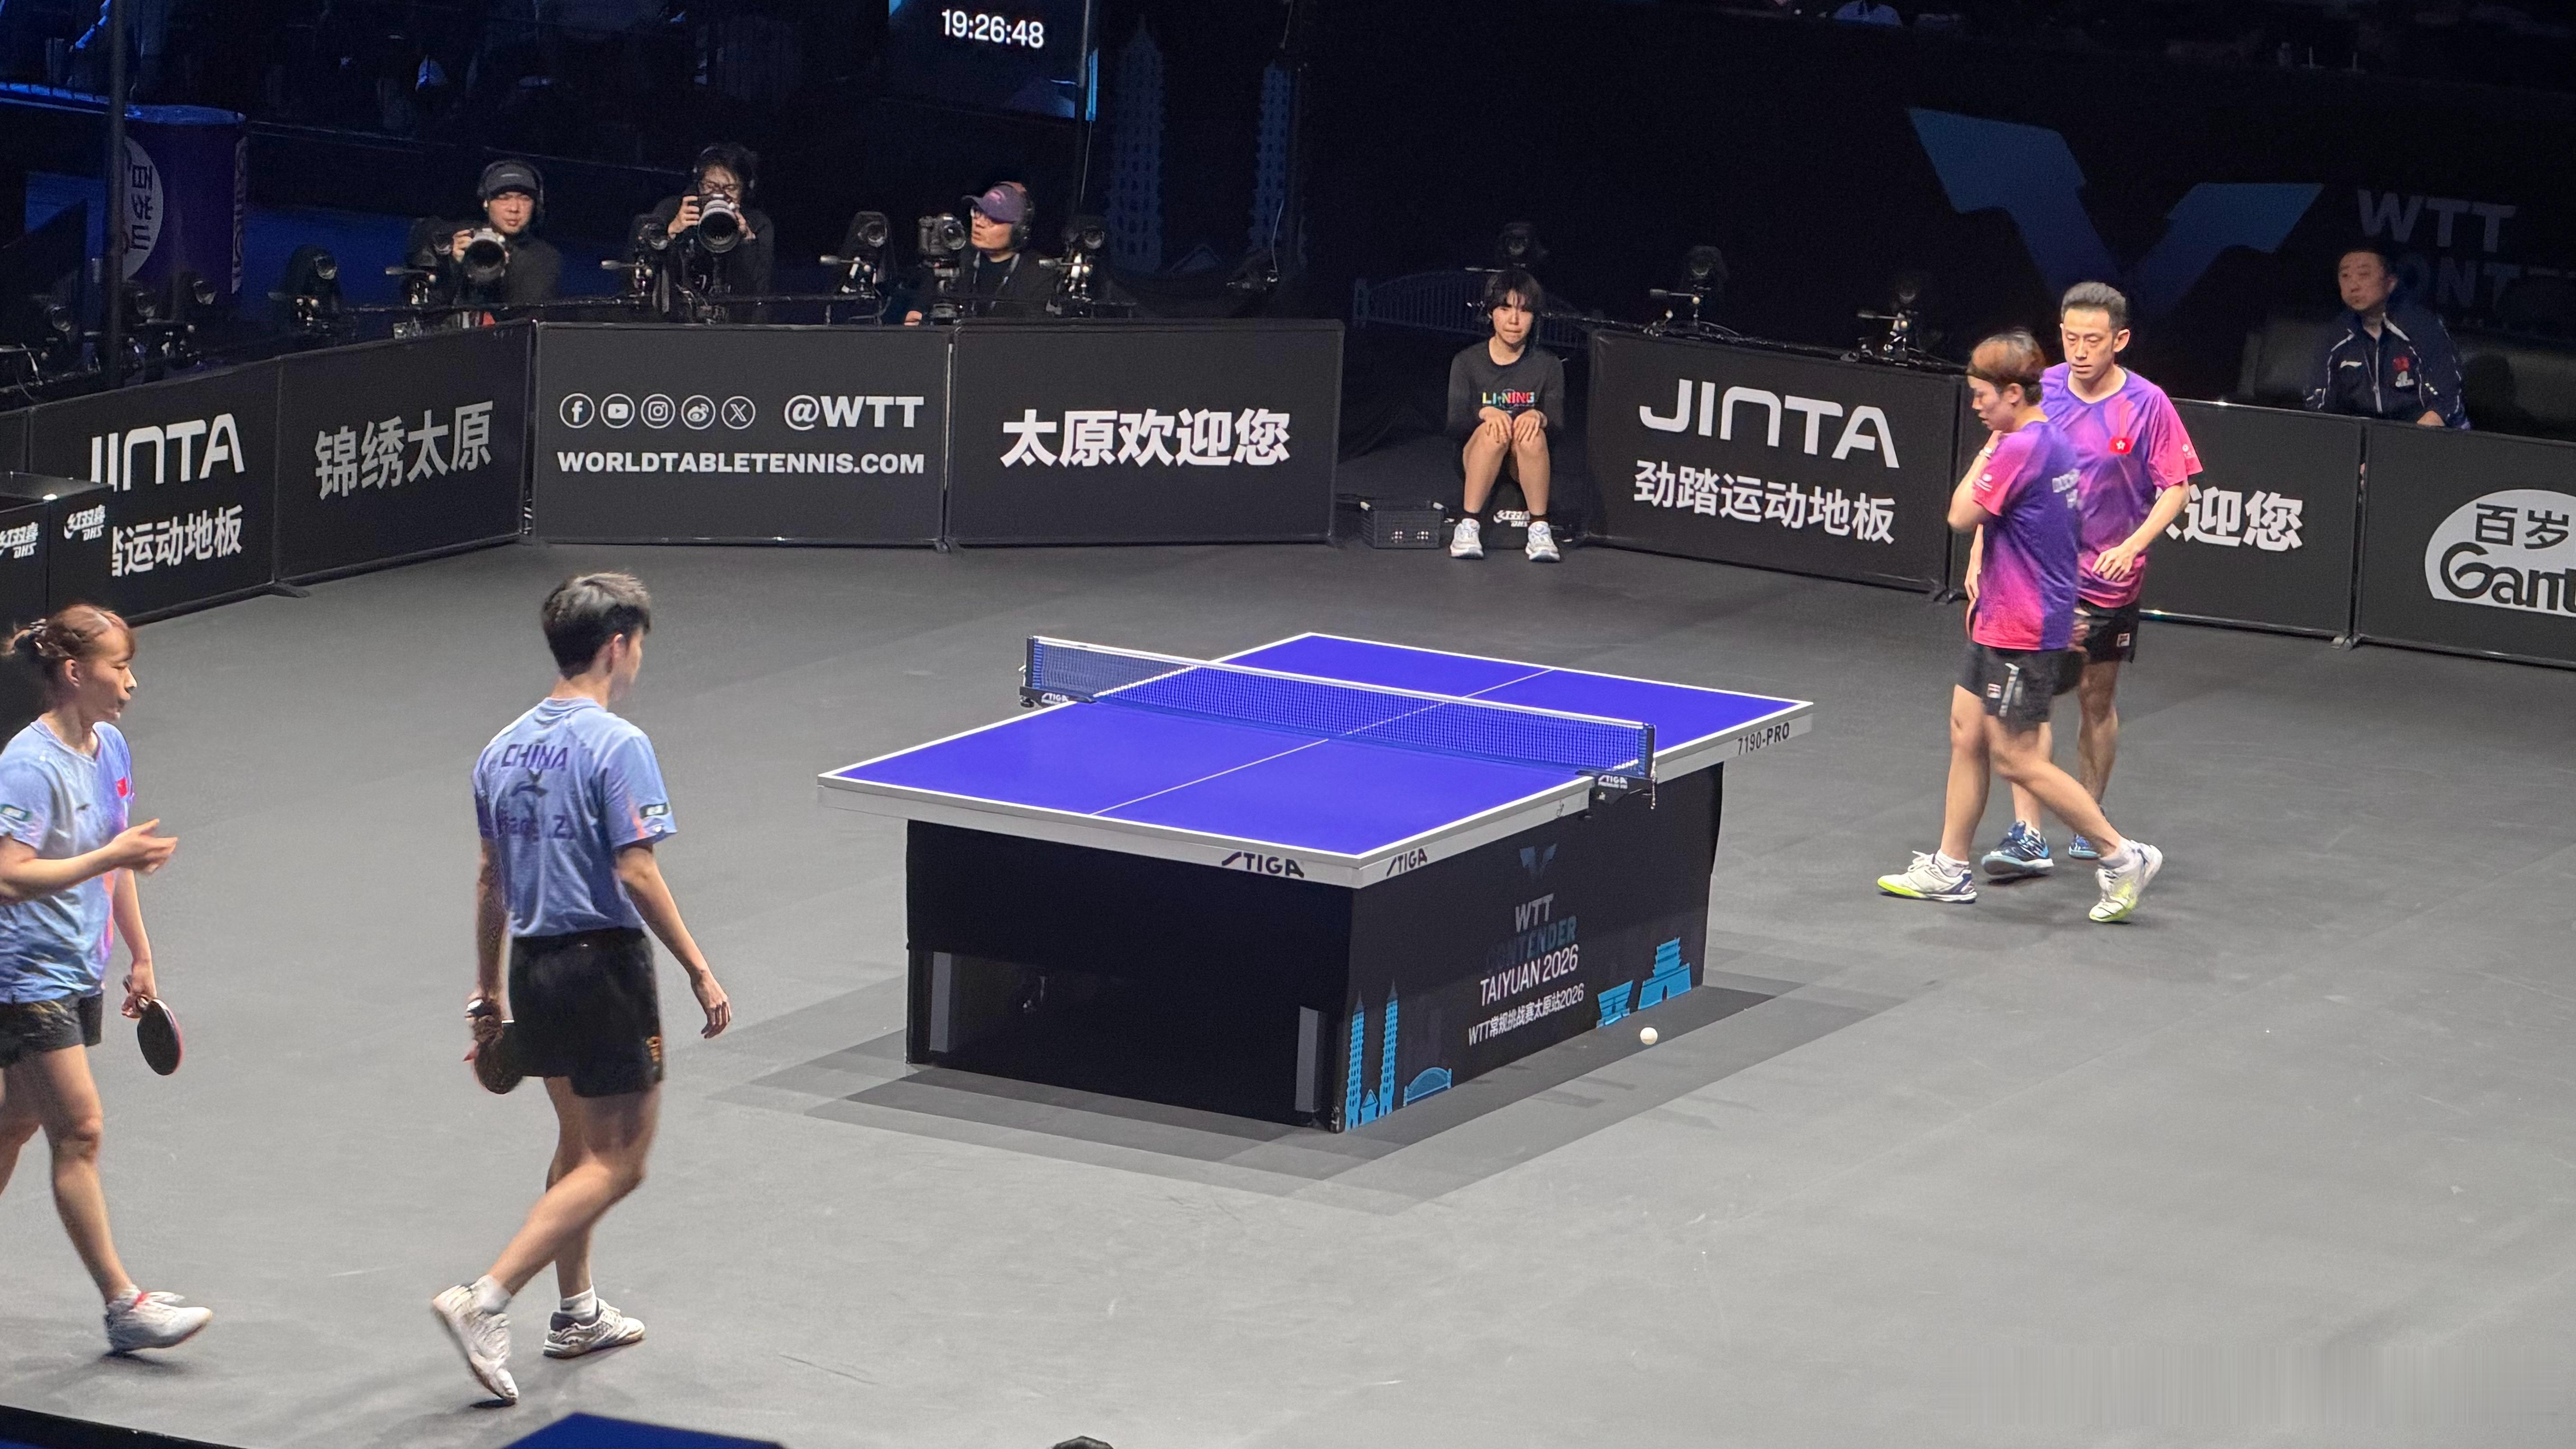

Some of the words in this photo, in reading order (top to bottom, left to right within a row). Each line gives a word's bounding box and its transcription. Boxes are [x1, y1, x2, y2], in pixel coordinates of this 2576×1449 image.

[941, 9, 1044, 49] 19:26:48
[130, 164, 153, 252] 百岁山
[2357, 189, 2516, 253] WTT
[784, 395, 924, 431] @WTT
[1639, 379, 1900, 469] JINTA
[315, 401, 493, 500] 锦绣太原
[1000, 408, 1291, 468] 太原欢迎您
[557, 451, 924, 474] WORLDTABLETENNIS.COM
[1633, 460, 1896, 544] 劲踏运动地板
[2165, 483, 2303, 552] 迎您
[82, 524, 105, 541] DHS
[2475, 503, 2570, 549] 百岁
[12, 542, 37, 559] DHS
[501, 744, 568, 771] CHINA
[1738, 722, 1790, 755] 7190-PRO
[1221, 851, 1305, 879] STIGA
[1386, 848, 1428, 877] STIGA
[1515, 892, 1555, 933] WTT
[1480, 958, 1541, 1007] TAIYUAN
[1543, 944, 1579, 983] 2026
